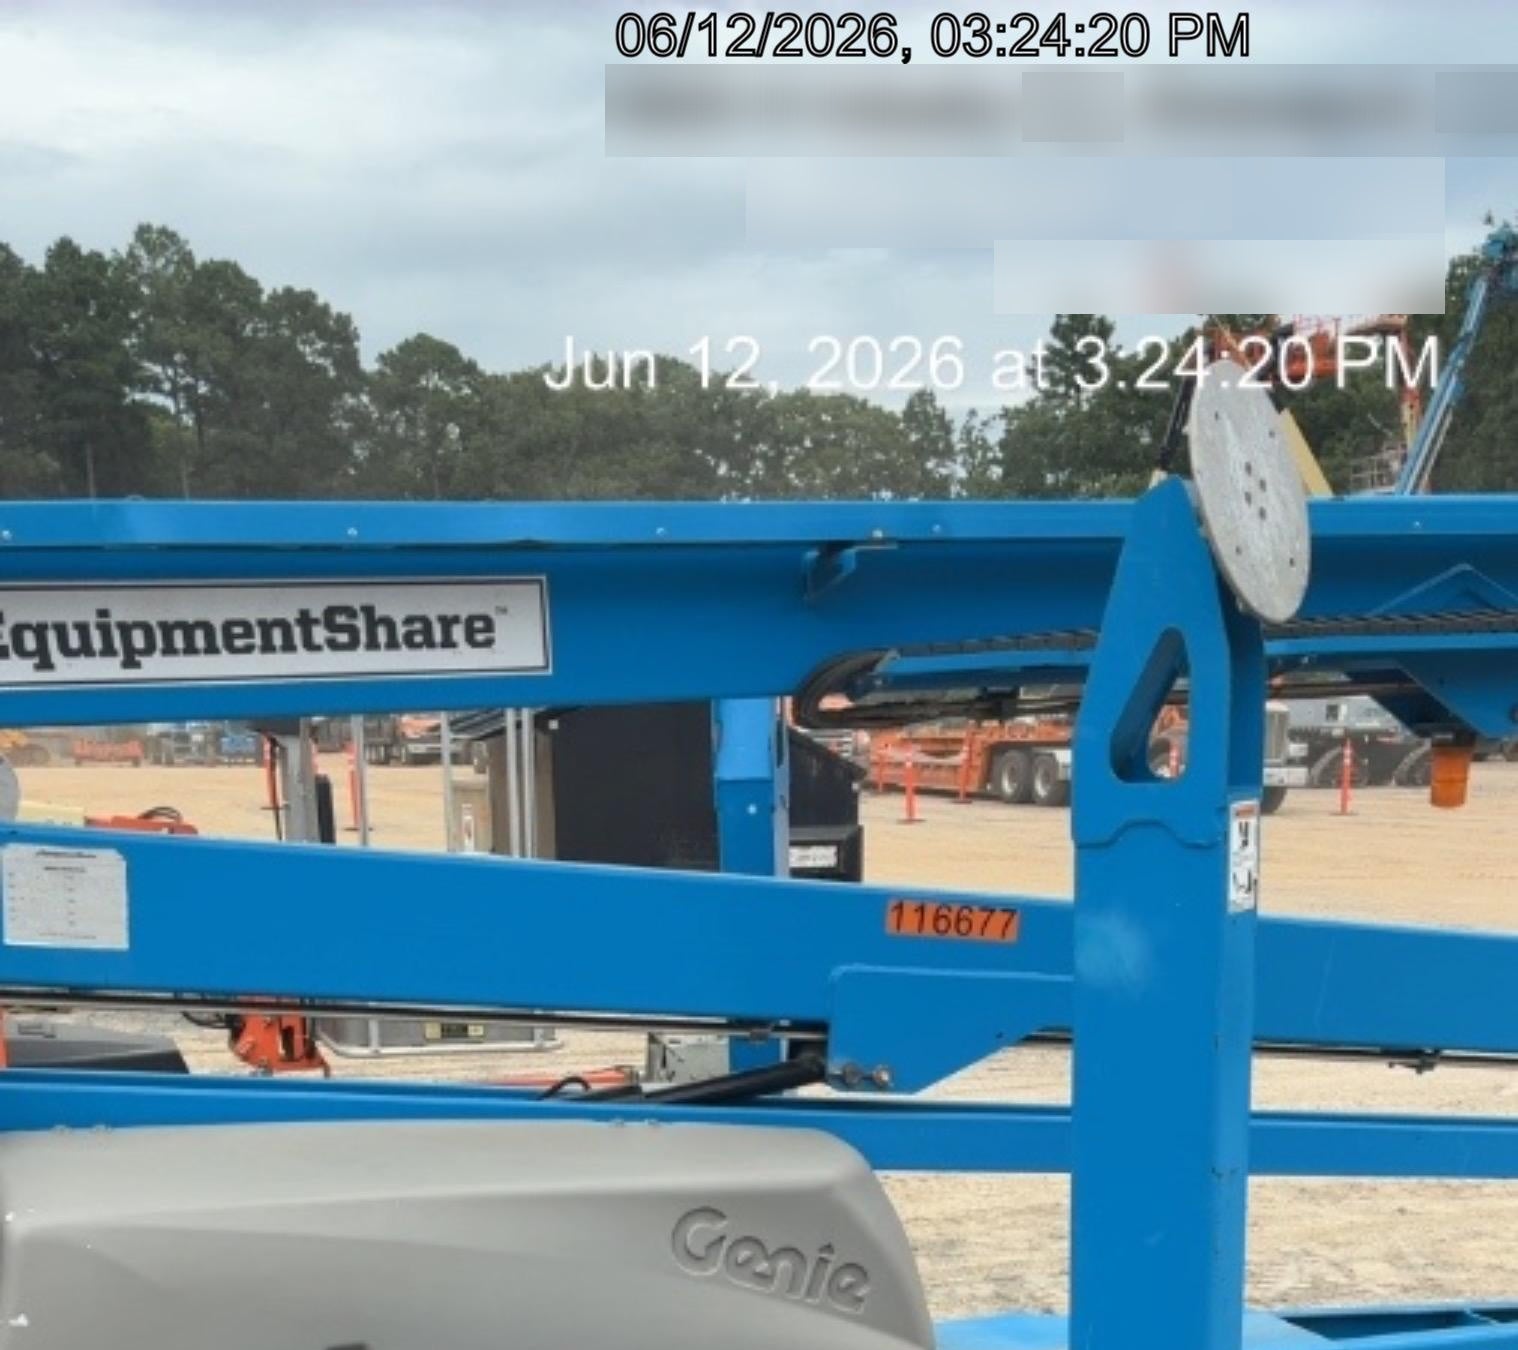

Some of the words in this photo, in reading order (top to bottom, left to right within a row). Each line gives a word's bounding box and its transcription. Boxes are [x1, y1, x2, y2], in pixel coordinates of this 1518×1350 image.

[0, 605, 496, 672] quipmentShare
[891, 901, 1017, 939] 116677
[671, 1206, 870, 1314] Genie
